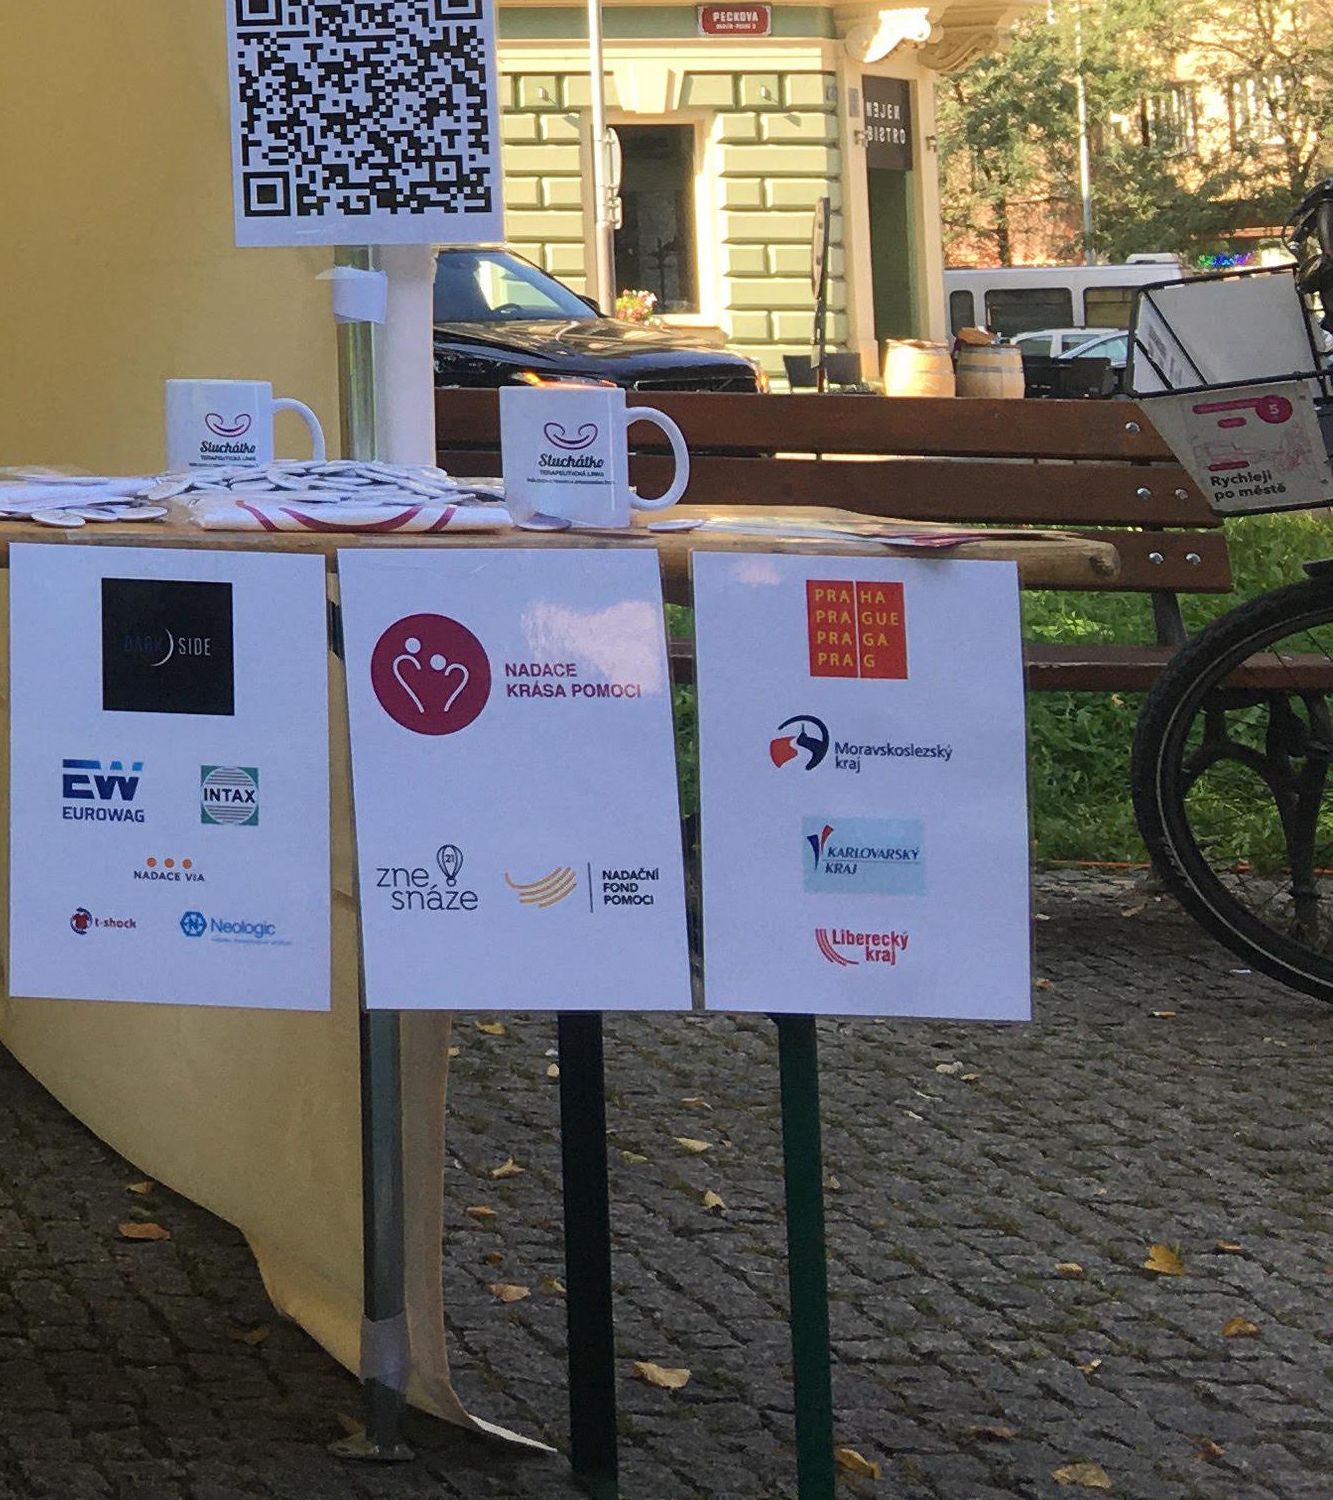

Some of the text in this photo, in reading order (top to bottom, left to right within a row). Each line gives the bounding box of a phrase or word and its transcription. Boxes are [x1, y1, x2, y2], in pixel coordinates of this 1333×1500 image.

[712, 11, 759, 22] PECKOVA
[867, 125, 907, 145] BISTRO
[1268, 404, 1280, 415] 5
[200, 441, 256, 454] Sluchátko
[538, 453, 605, 468] Sluchátko
[1209, 469, 1273, 488] Rychleji
[1214, 482, 1287, 502] po městě
[178, 637, 211, 656] SIDE
[505, 663, 577, 677] NADACE
[507, 680, 641, 698] KRÁSA POMOCI
[834, 741, 953, 762] Moravskoslezský
[835, 756, 861, 774] kraj
[203, 788, 255, 804] INTAX
[62, 806, 145, 823] EUROWAG
[827, 845, 920, 861] KARLOVARSKÝ
[134, 870, 181, 882] NADACE
[602, 867, 660, 881] NADAČNÍ
[825, 862, 858, 875] KRAJ
[376, 866, 429, 888] zne
[603, 883, 639, 892] FOND
[391, 884, 479, 911] snáze
[604, 894, 653, 905] POMOCI
[95, 917, 137, 929] t-shock
[211, 918, 276, 939] Neologic
[832, 928, 909, 951] Liberecký
[865, 946, 896, 966] kraj
